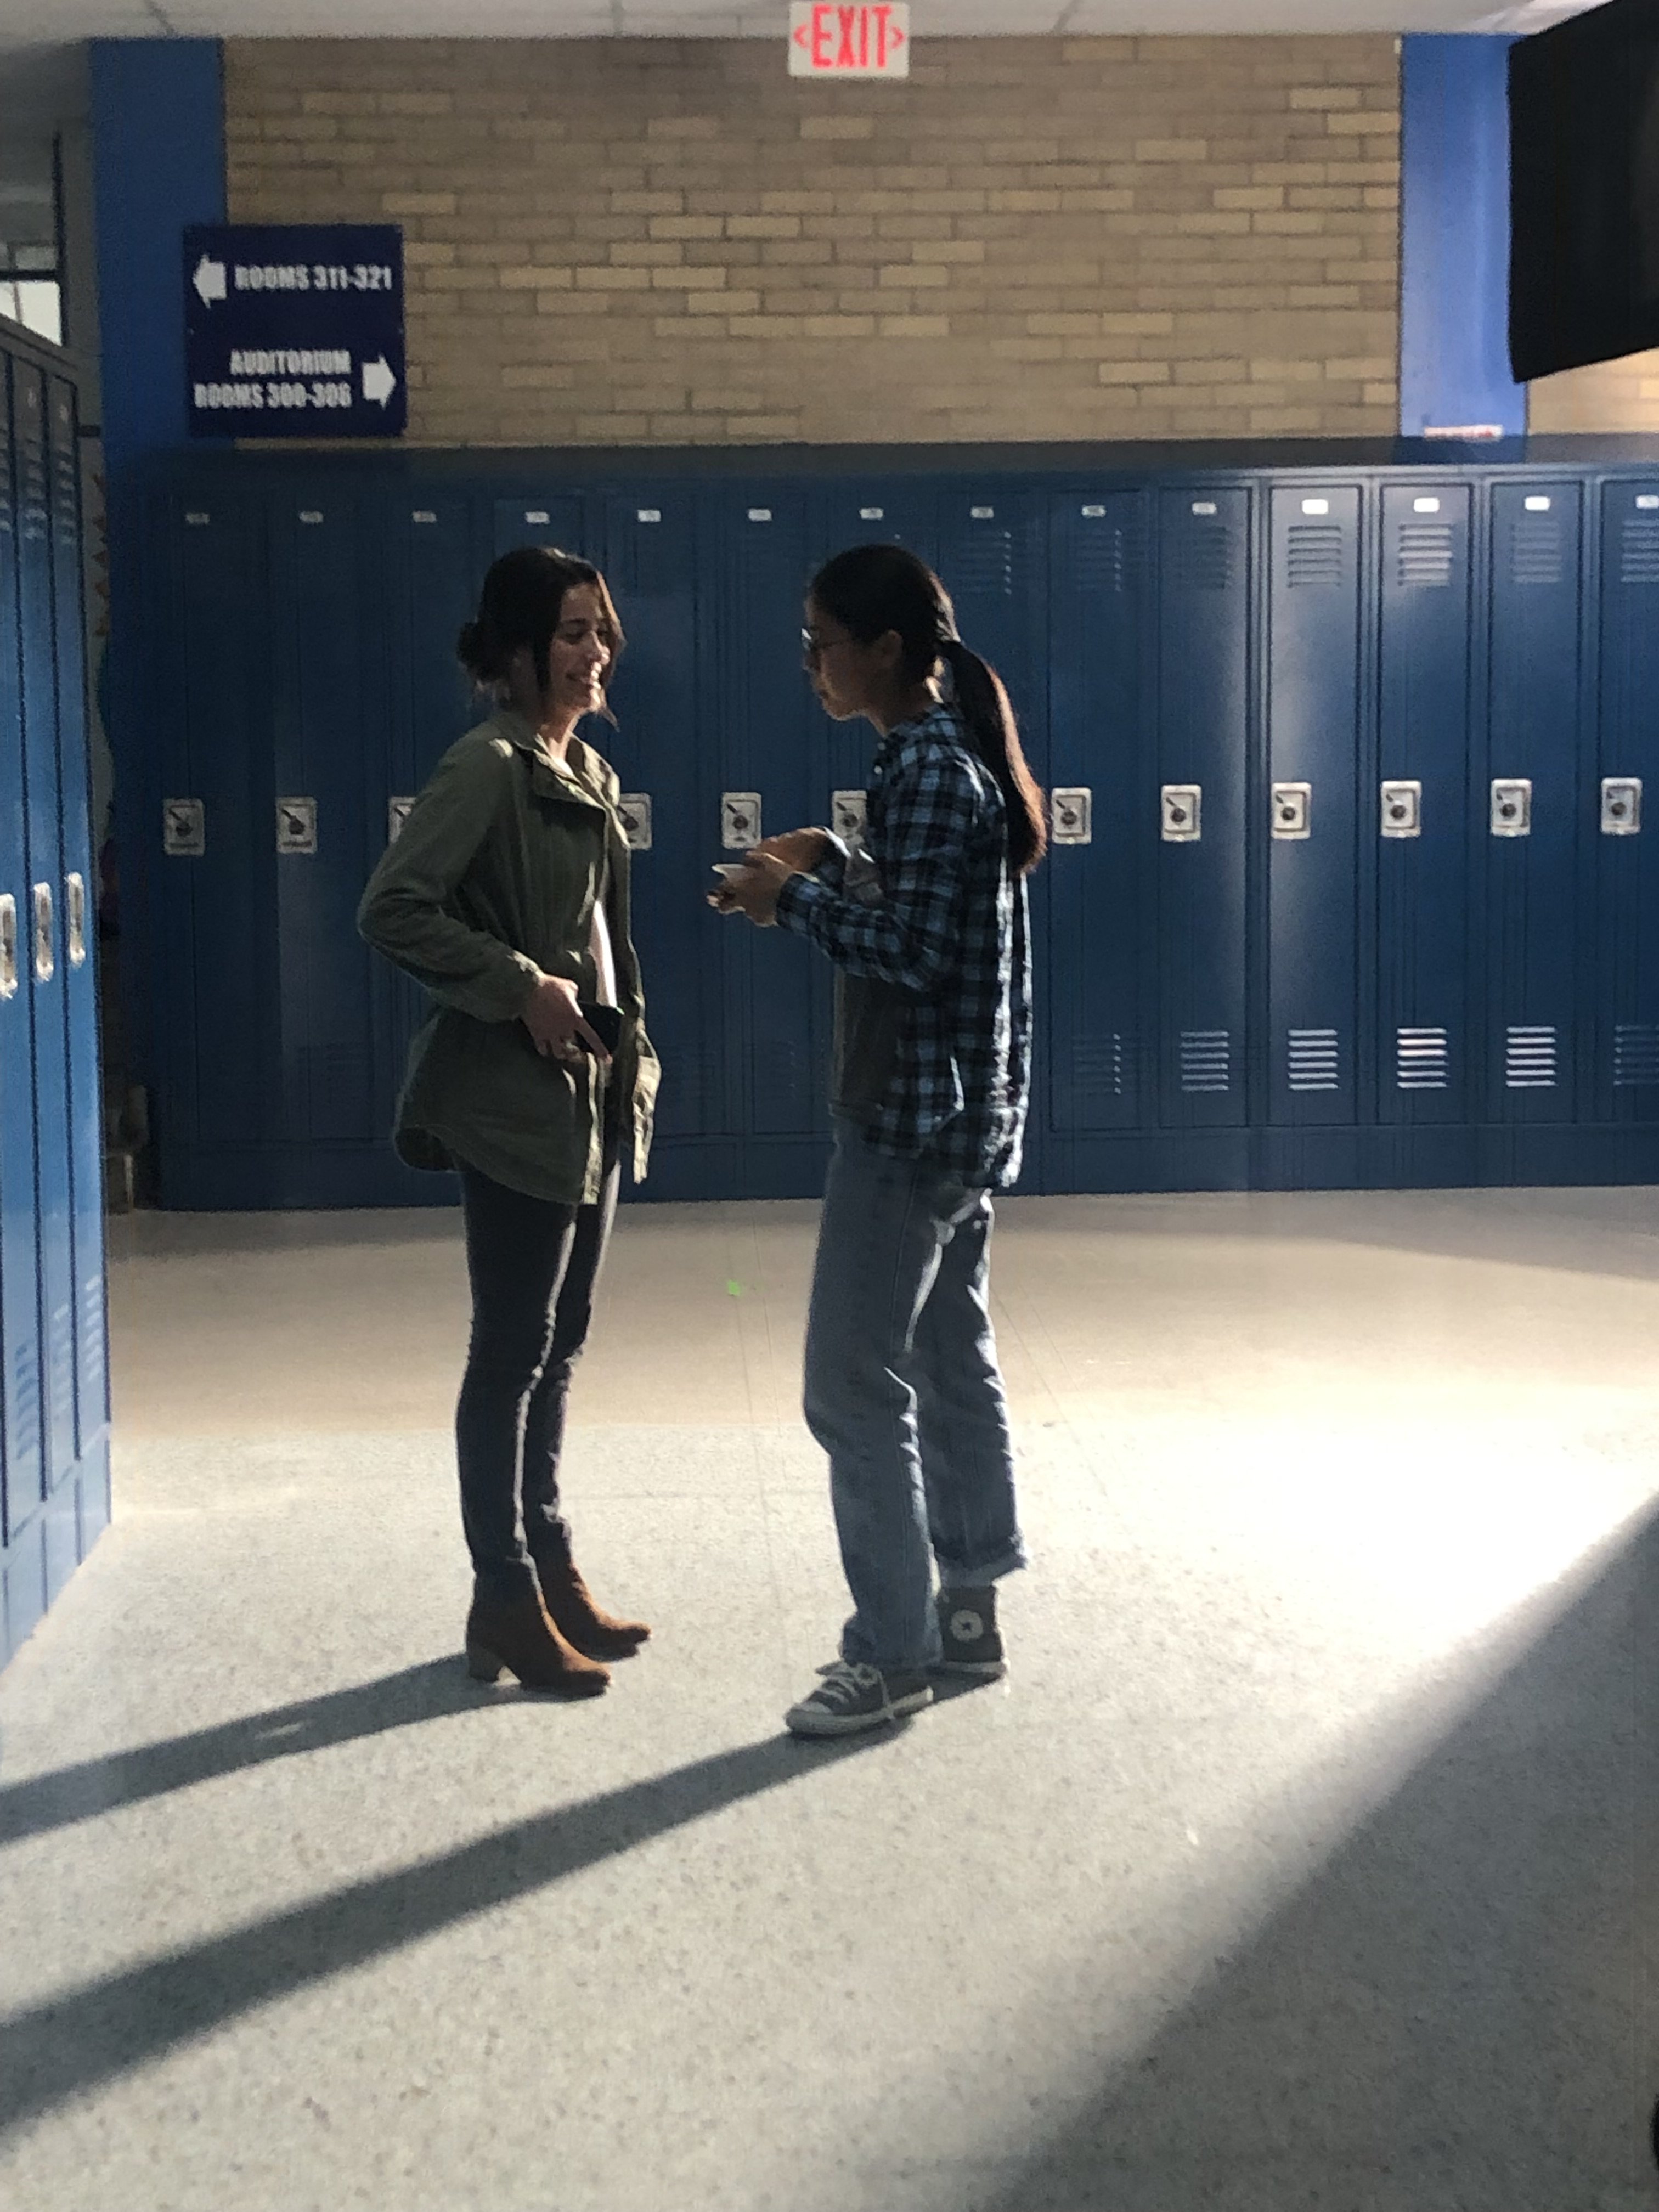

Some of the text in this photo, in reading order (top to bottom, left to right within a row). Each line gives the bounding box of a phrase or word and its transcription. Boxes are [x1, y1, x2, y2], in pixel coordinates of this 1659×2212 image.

[812, 4, 892, 67] EXIT
[234, 264, 392, 290] ROOMS 311-321
[230, 349, 352, 375] AUDITORIUM
[194, 382, 264, 408] ROOMS
